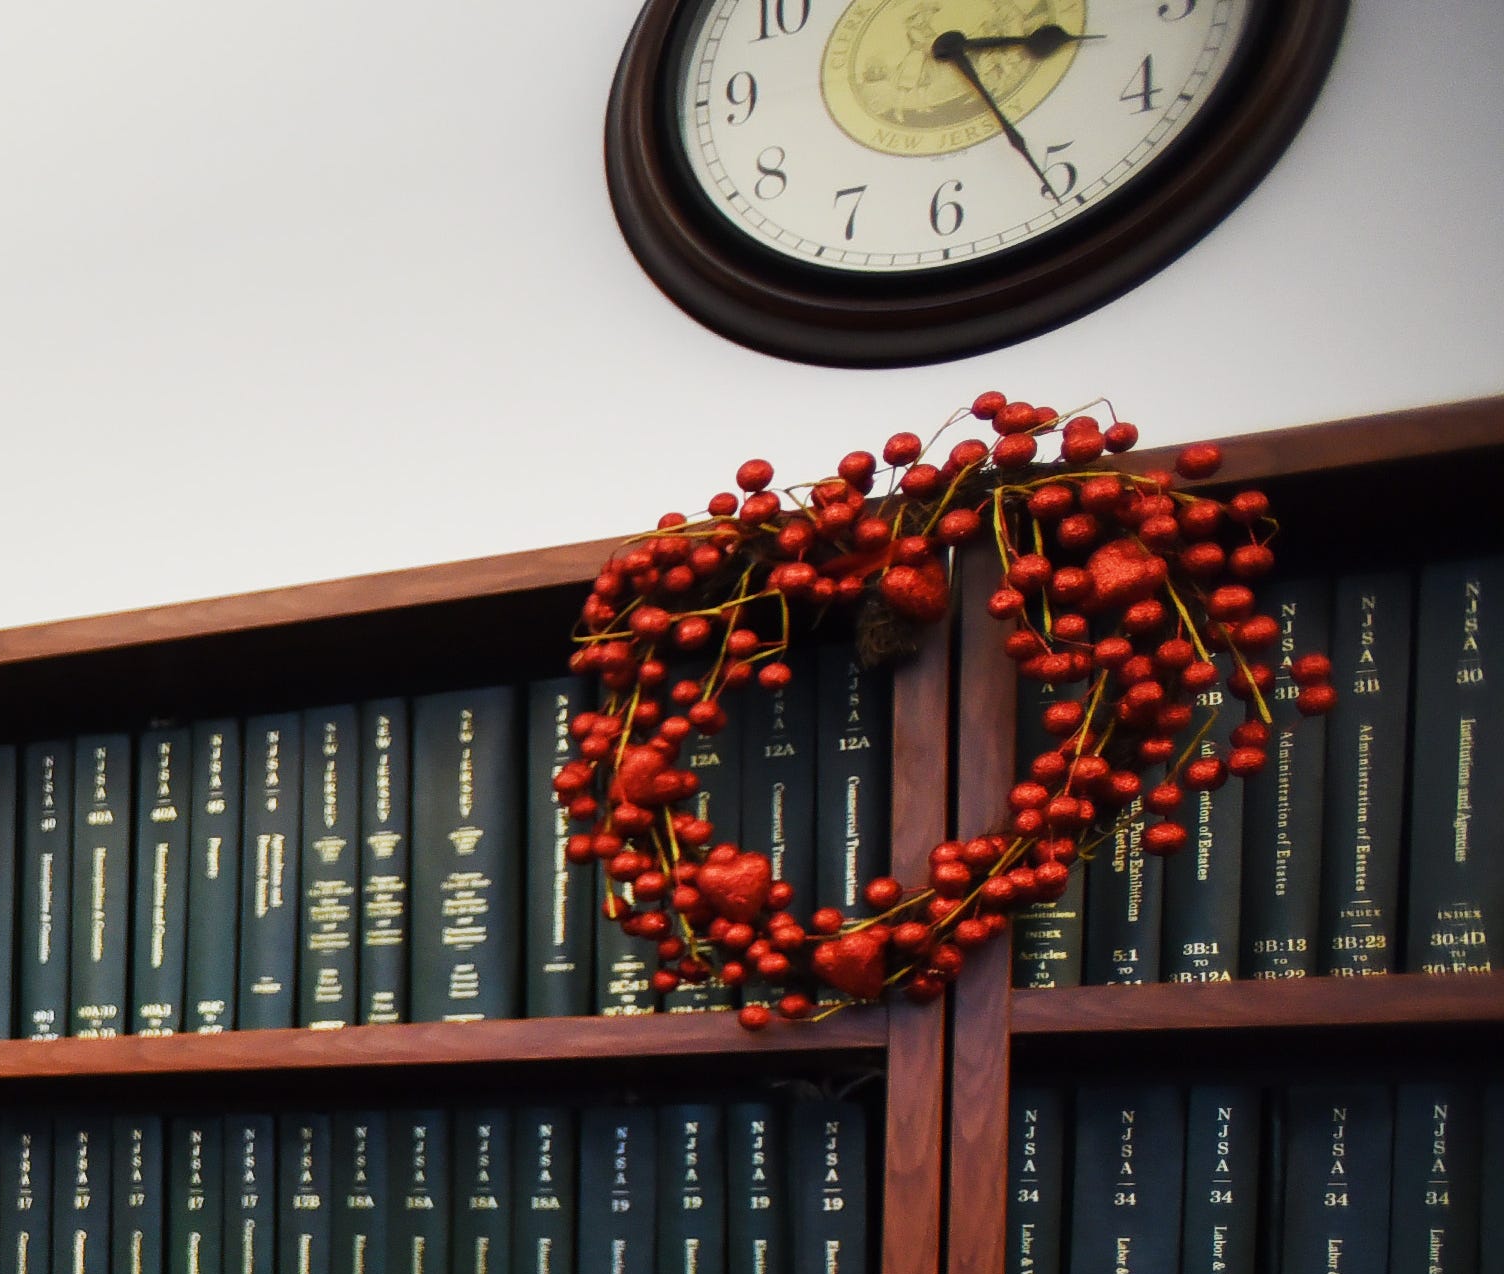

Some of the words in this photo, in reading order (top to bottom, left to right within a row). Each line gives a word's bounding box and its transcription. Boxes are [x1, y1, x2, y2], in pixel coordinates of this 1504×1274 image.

[1119, 54, 1164, 116] 4
[726, 71, 759, 125] 9
[754, 146, 789, 200] 8
[1040, 141, 1079, 198] 5
[833, 185, 868, 240] 7
[929, 180, 965, 237] 6
[1456, 667, 1485, 685] 30
[1275, 684, 1301, 700] 3B
[1353, 678, 1381, 694] 3B
[1196, 691, 1224, 706] 3B
[765, 743, 795, 758] 12A
[839, 736, 871, 752] 12A
[690, 753, 721, 768] 12A
[1276, 731, 1294, 828] Administration
[1356, 722, 1374, 822] Administration
[1276, 832, 1292, 845] of
[1356, 828, 1372, 841] of
[1196, 839, 1212, 881] Estates
[1354, 844, 1371, 892] Estates
[1275, 849, 1291, 896] Estates
[1127, 859, 1144, 922] Exhibitions
[1254, 938, 1308, 953] 3B:13
[1331, 934, 1388, 950] 3B:23
[1430, 931, 1487, 946] 30:4D
[1182, 942, 1220, 956] 3B:1
[682, 1195, 703, 1210] 19
[749, 1195, 771, 1210] 19
[1017, 1189, 1039, 1202] 34
[1114, 1192, 1137, 1206] 34
[1209, 1190, 1234, 1204] 34
[1324, 1193, 1350, 1206] 34
[1425, 1191, 1450, 1206] 34
[611, 1199, 631, 1212] 19
[822, 1197, 844, 1211] 19
[1212, 1225, 1228, 1259] Labor
[1429, 1229, 1445, 1263] Labor
[1116, 1237, 1132, 1266] Labor
[1327, 1239, 1343, 1269] Labor
[1020, 1257, 1033, 1267] &
[1212, 1261, 1226, 1271] &
[1429, 1266, 1442, 1274] &
